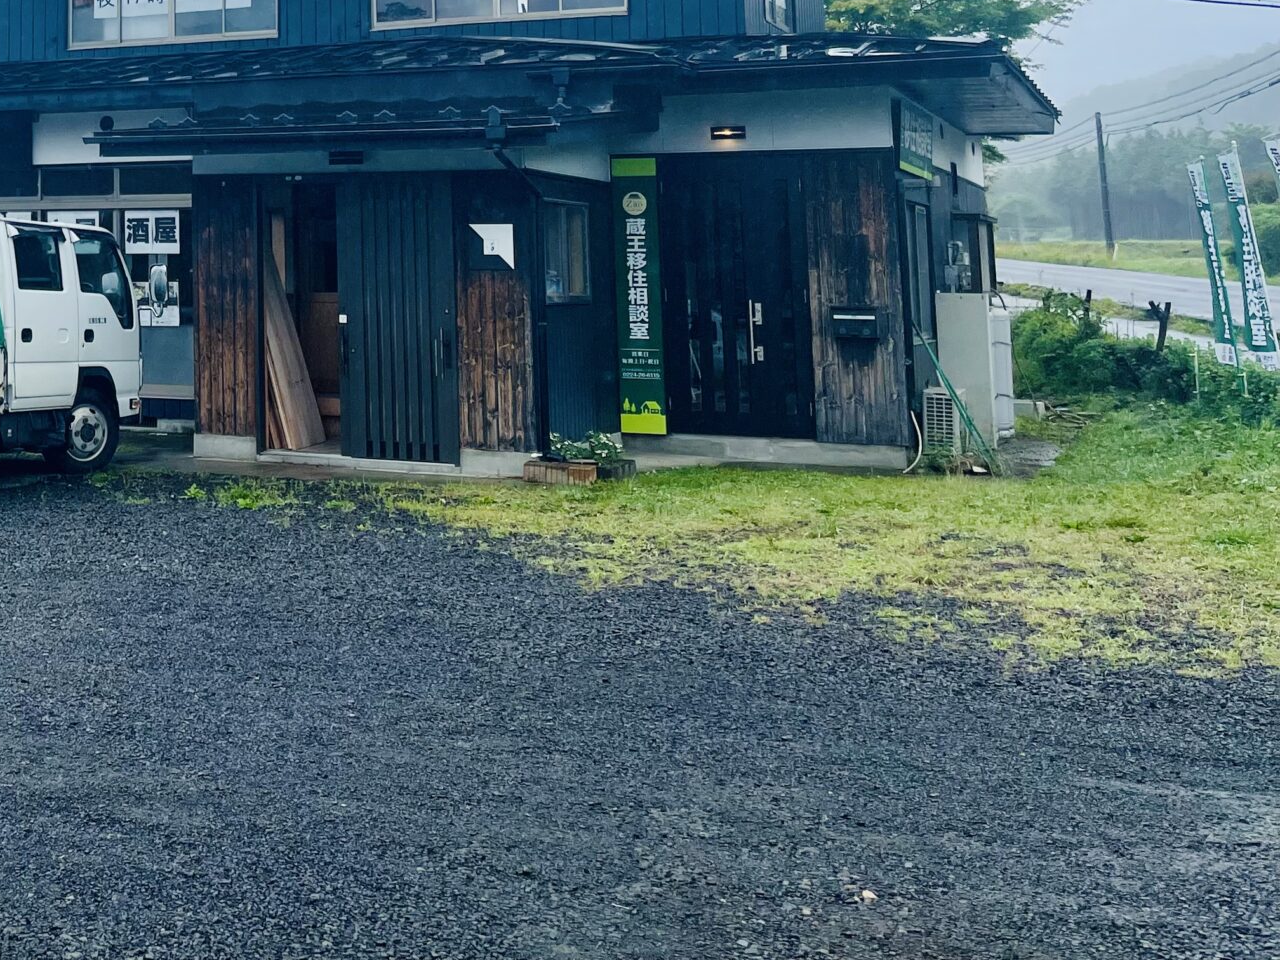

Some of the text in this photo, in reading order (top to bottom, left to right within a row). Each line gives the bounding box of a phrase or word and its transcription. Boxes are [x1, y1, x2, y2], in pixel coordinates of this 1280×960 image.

[126, 217, 178, 244] 酒屋
[625, 218, 650, 340] 蔵王移住相談室
